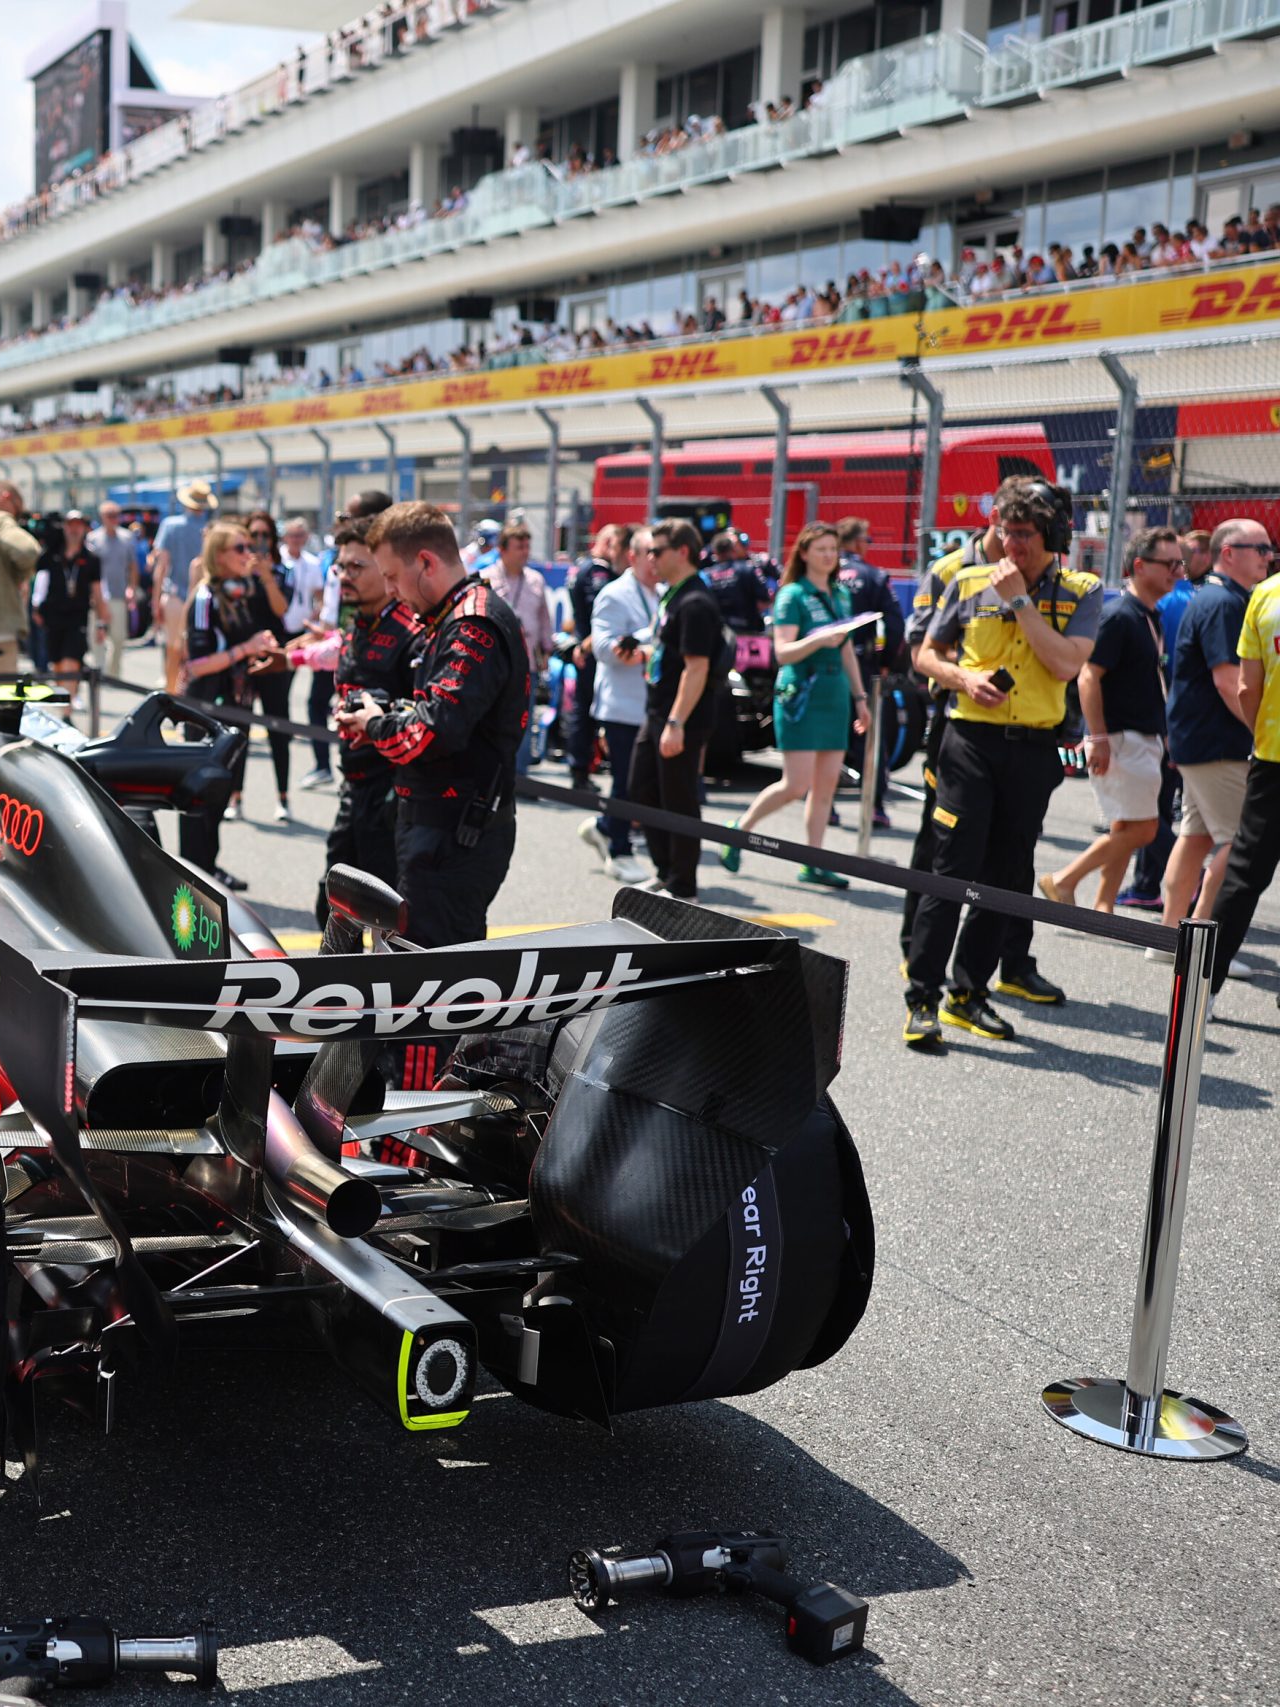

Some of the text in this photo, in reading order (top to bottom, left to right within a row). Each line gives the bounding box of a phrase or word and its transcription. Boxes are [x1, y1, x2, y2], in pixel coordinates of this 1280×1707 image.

[1190, 275, 1280, 320] DH
[962, 303, 1077, 344] DHL
[651, 351, 719, 379] DHL
[790, 328, 876, 365] DHL
[444, 379, 491, 402] DHL
[535, 366, 593, 392] DHL
[199, 904, 220, 957] bp
[203, 950, 645, 1035] Revolut
[738, 1177, 767, 1324] ear Right
